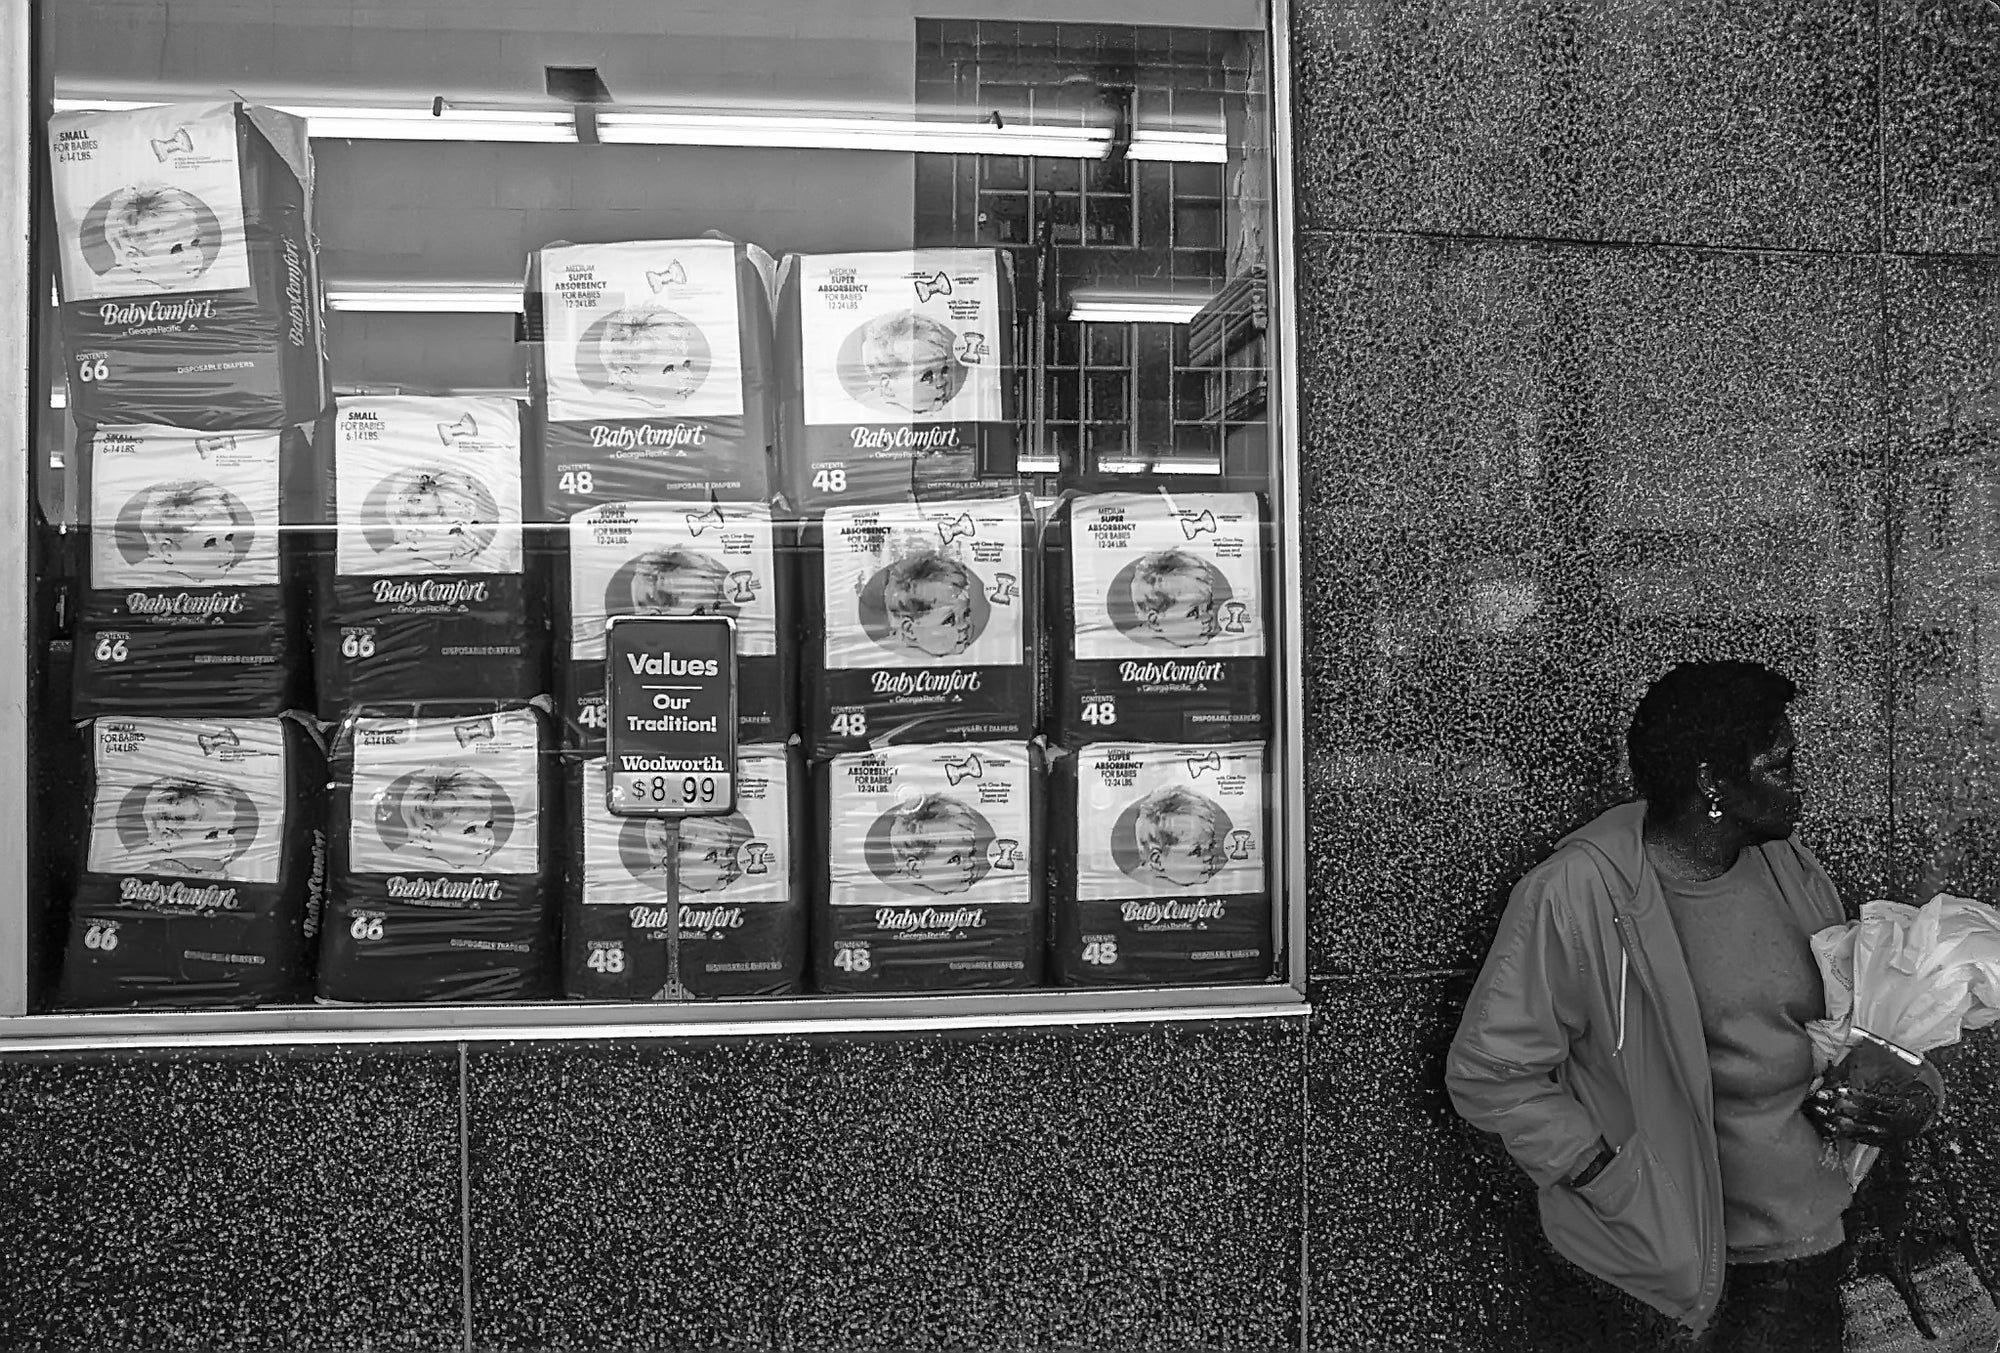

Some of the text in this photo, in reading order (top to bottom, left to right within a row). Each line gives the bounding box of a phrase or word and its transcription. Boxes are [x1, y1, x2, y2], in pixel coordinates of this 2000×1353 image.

[60, 130, 89, 141] SMALL
[54, 141, 97, 152] FOR BABIES
[555, 282, 607, 290] ABSORBENCY
[76, 352, 109, 361] CONTENTS
[80, 359, 109, 382] 66
[177, 361, 254, 374] DISPOSABLE DIAPERS
[348, 412, 378, 420] SMALL
[340, 422, 385, 431] FOR BABIES
[559, 471, 593, 494] 48
[667, 482, 709, 490] DISPOSABLE
[812, 469, 847, 492] 48
[840, 527, 891, 535] ABSORBENCY
[96, 639, 128, 662] 66
[342, 634, 376, 657] 66
[627, 652, 719, 677] Values
[653, 694, 691, 710] Our
[1081, 703, 1117, 725] 48
[627, 716, 717, 732] Tradition!
[831, 713, 867, 736] 48
[101, 734, 117, 743] FOR
[620, 755, 724, 772] Woolworth
[855, 776, 868, 784] FOR
[1102, 770, 1114, 778] FOR
[351, 917, 384, 940] 66
[85, 926, 118, 950] 66
[587, 949, 625, 973] 48
[834, 949, 871, 972] 48
[1082, 942, 1118, 965] 48
